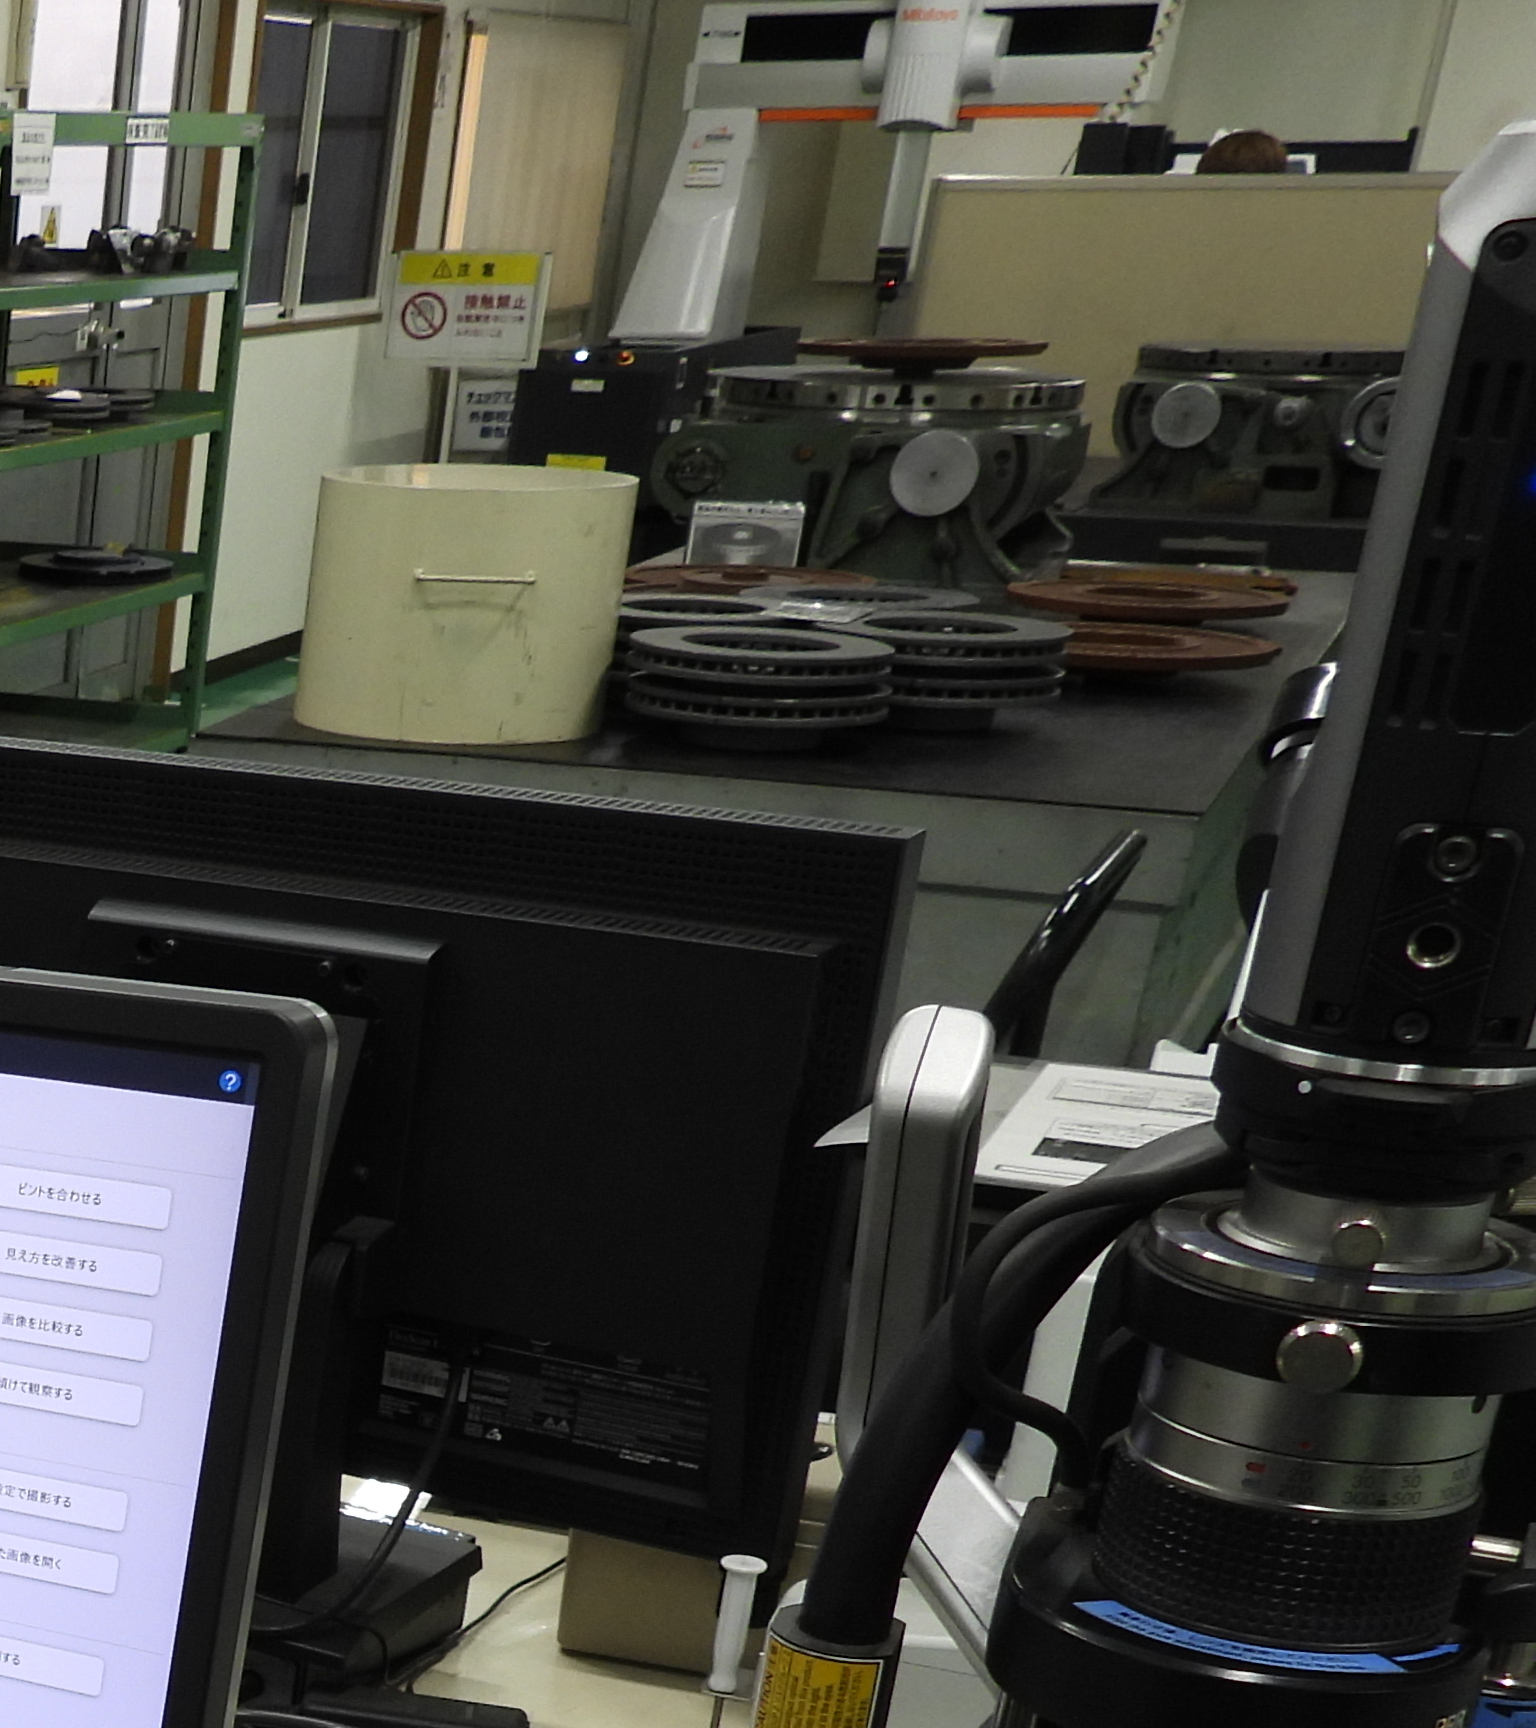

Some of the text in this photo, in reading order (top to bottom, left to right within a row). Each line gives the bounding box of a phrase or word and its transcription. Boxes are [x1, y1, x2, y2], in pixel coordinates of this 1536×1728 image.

[17, 1181, 102, 1207] ピントを合わせる
[5, 1247, 98, 1273] 見え方を改善する
[1, 1312, 84, 1338] 画像を比較する
